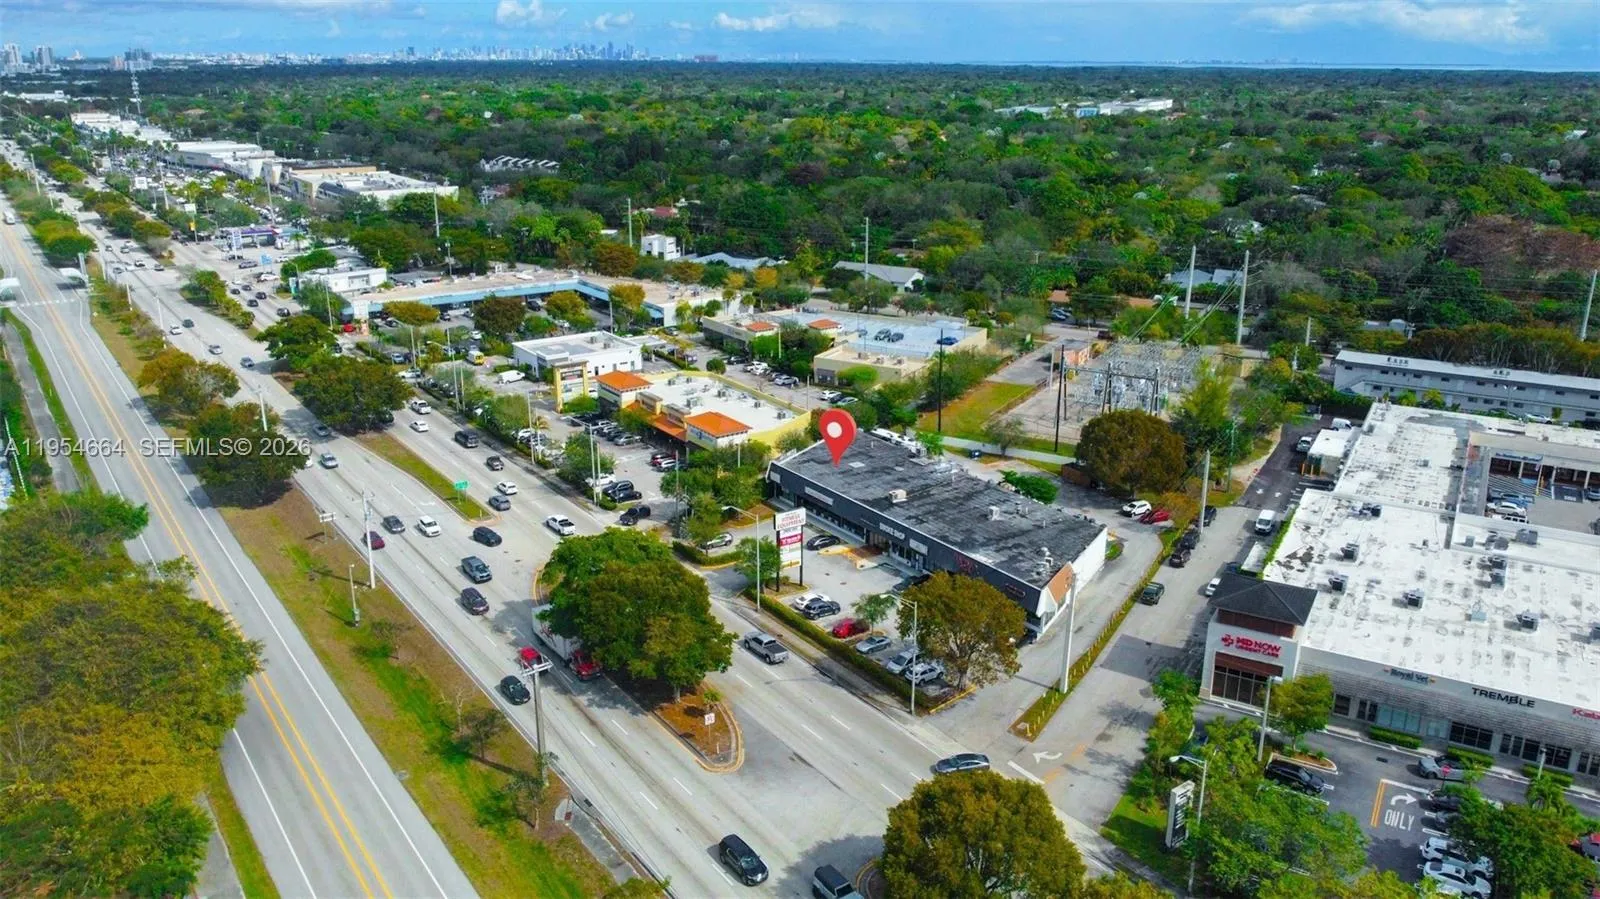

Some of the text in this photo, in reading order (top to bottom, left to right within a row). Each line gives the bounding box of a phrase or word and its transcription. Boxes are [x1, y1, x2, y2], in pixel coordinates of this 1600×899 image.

[1254, 641, 1281, 652] NOW
[1391, 668, 1414, 680] Royal
[1472, 687, 1535, 708] TREMBLE
[1384, 809, 1415, 831] ONLY
